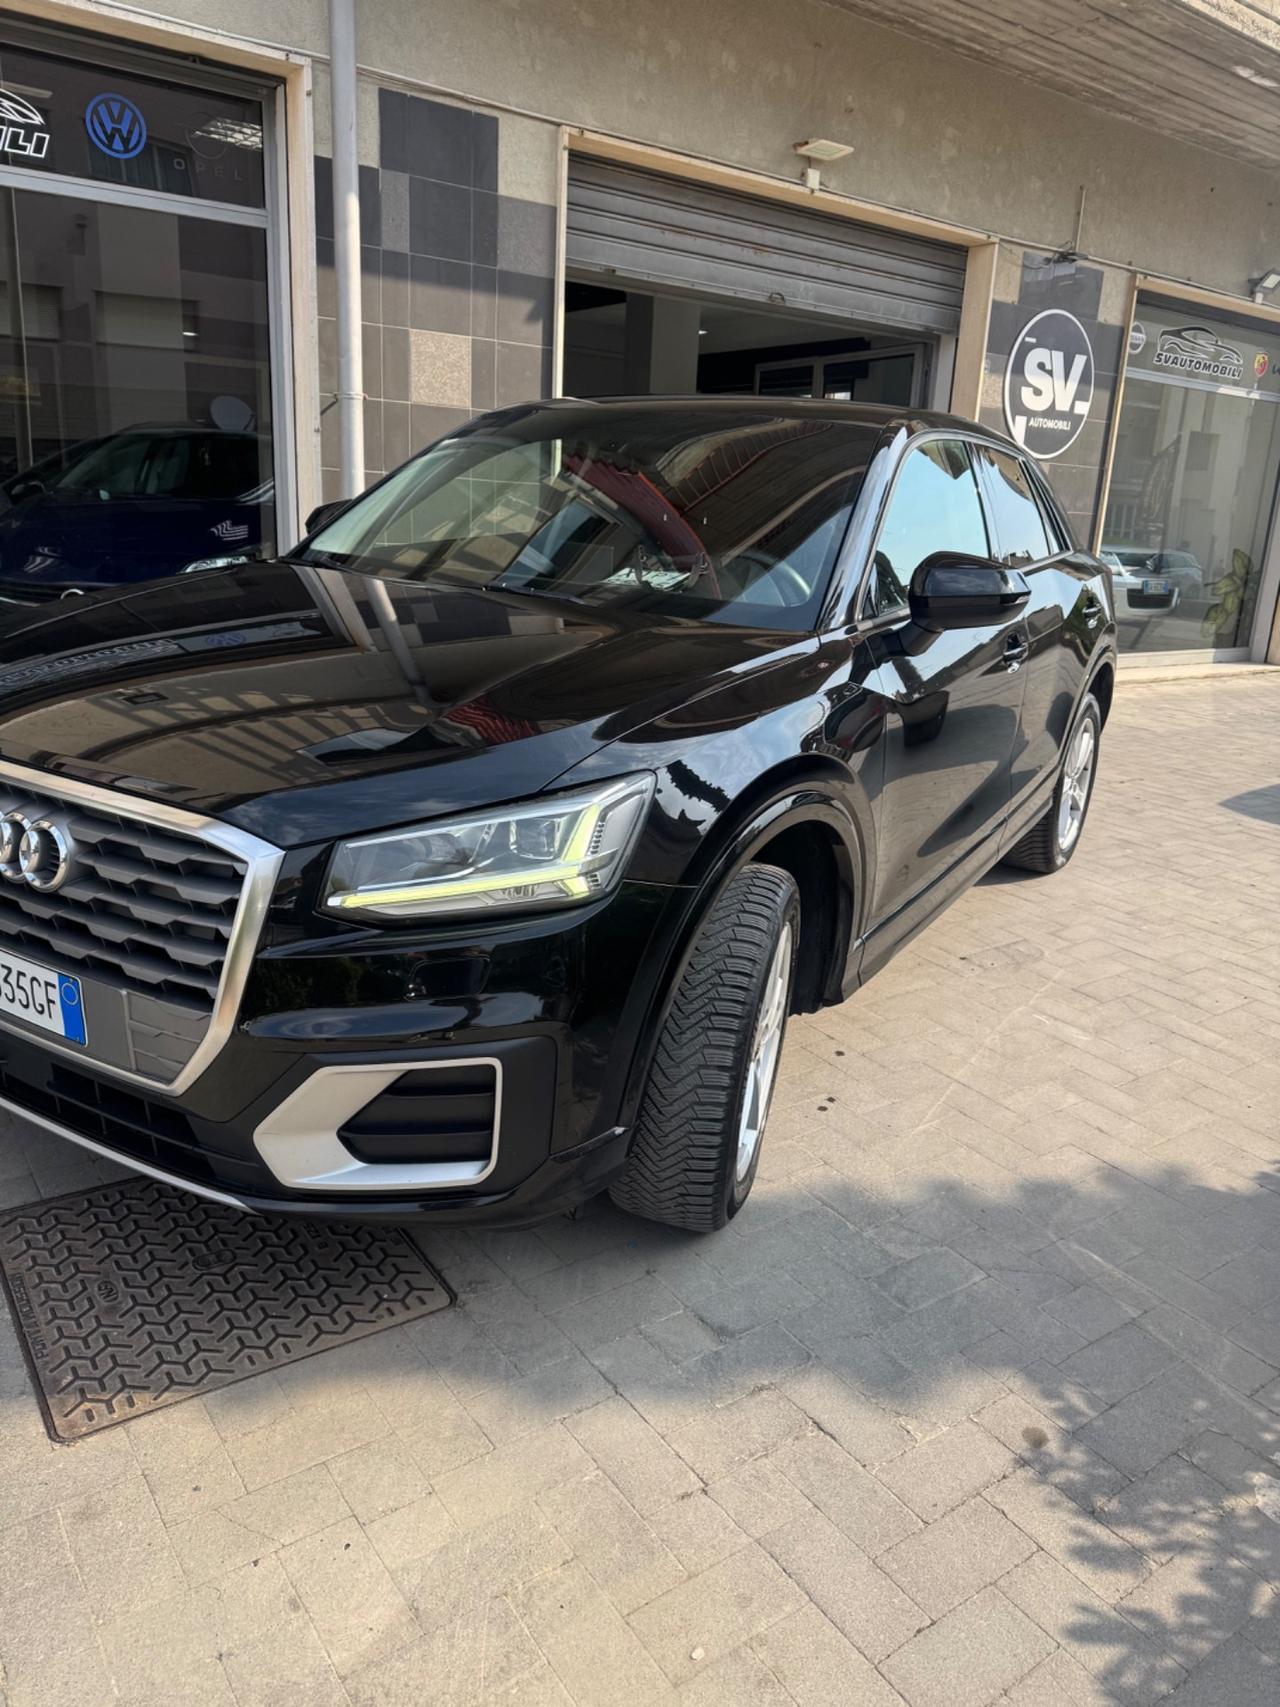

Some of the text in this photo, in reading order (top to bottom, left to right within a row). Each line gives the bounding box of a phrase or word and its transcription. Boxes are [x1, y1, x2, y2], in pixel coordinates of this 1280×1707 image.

[173, 157, 243, 182] OPEL
[1154, 352, 1243, 379] SVAUTOMOBILI
[1028, 416, 1071, 431] AUTOMOBILI
[0, 964, 56, 1019] 35GF
